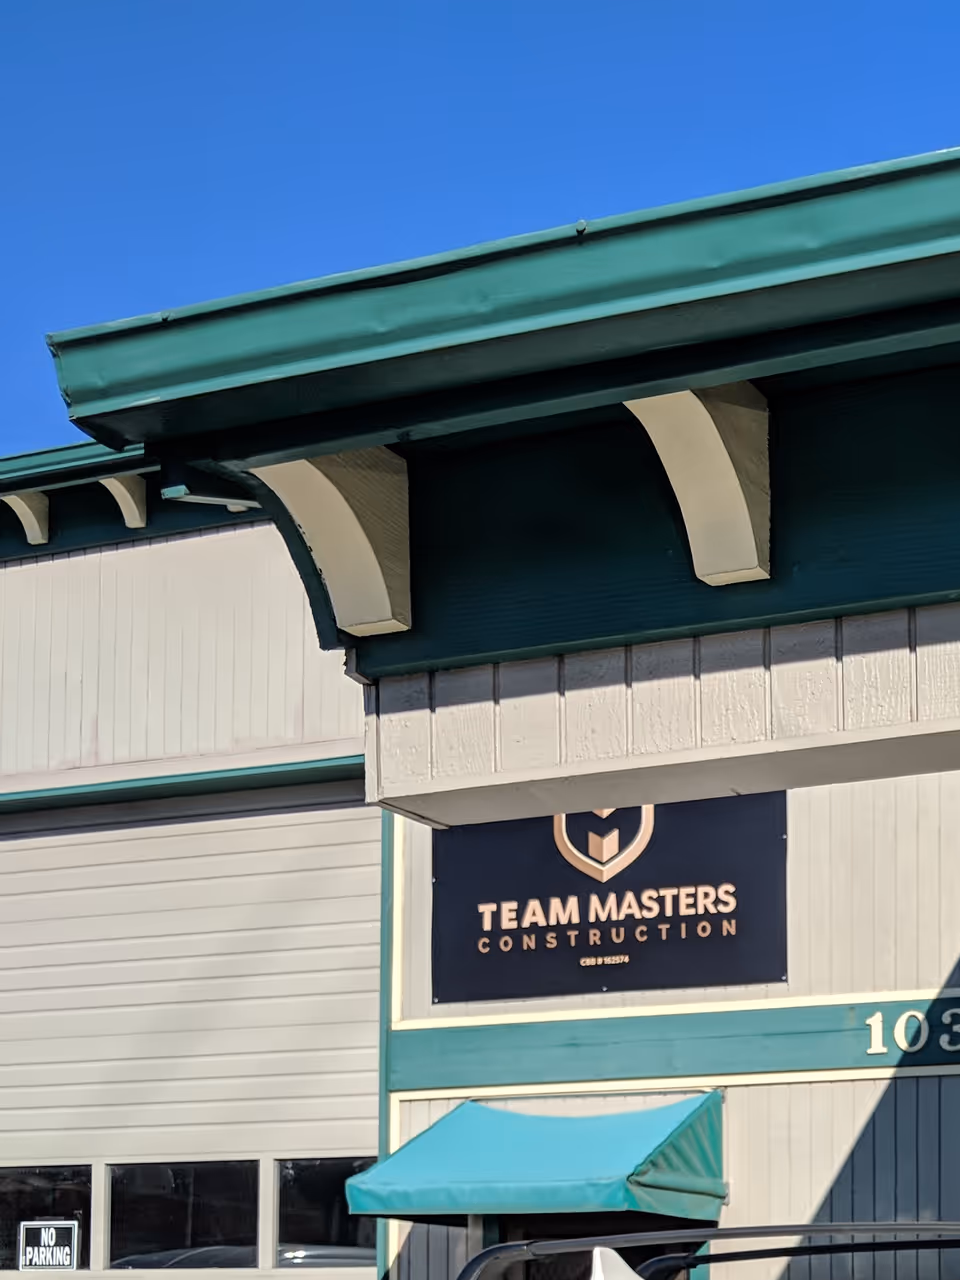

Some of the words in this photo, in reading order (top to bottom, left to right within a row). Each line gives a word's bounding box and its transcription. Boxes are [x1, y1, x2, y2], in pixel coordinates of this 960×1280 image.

[477, 895, 581, 932] TEAM
[588, 882, 738, 923] MASTERS
[477, 918, 737, 954] CONSTRUCTION
[41, 1227, 56, 1247] NO
[26, 1246, 71, 1266] PARKING
